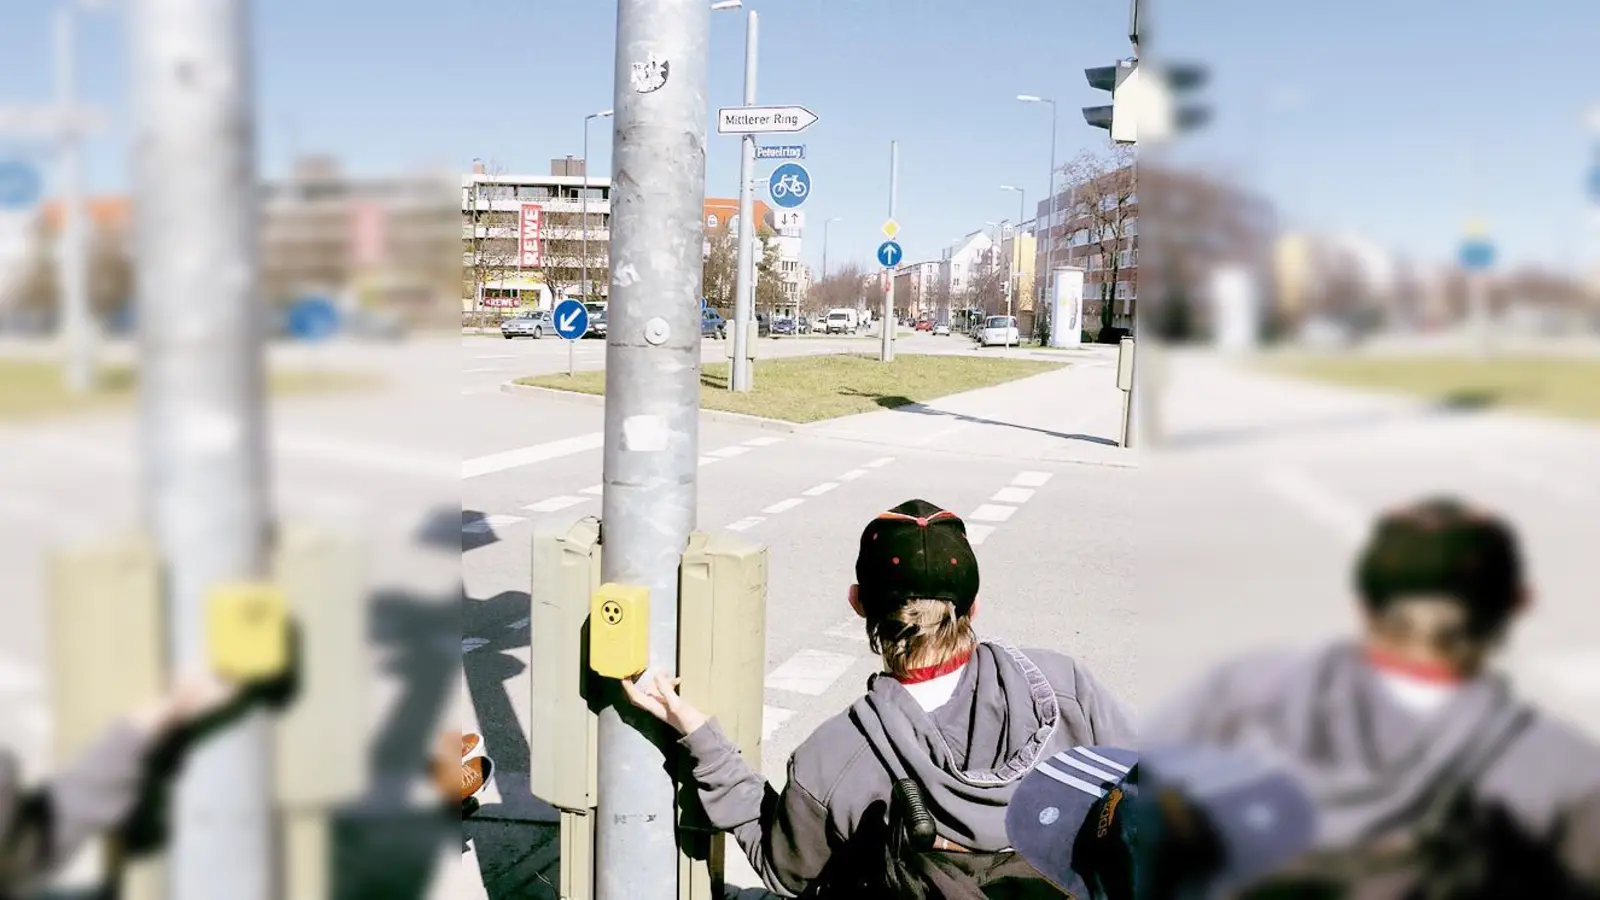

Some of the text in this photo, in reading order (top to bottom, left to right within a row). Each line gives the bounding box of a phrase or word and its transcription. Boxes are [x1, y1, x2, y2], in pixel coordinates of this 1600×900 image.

[725, 113, 798, 126] Mittlerer Ring
[757, 146, 801, 158] Petuelring
[522, 208, 540, 265] REWE
